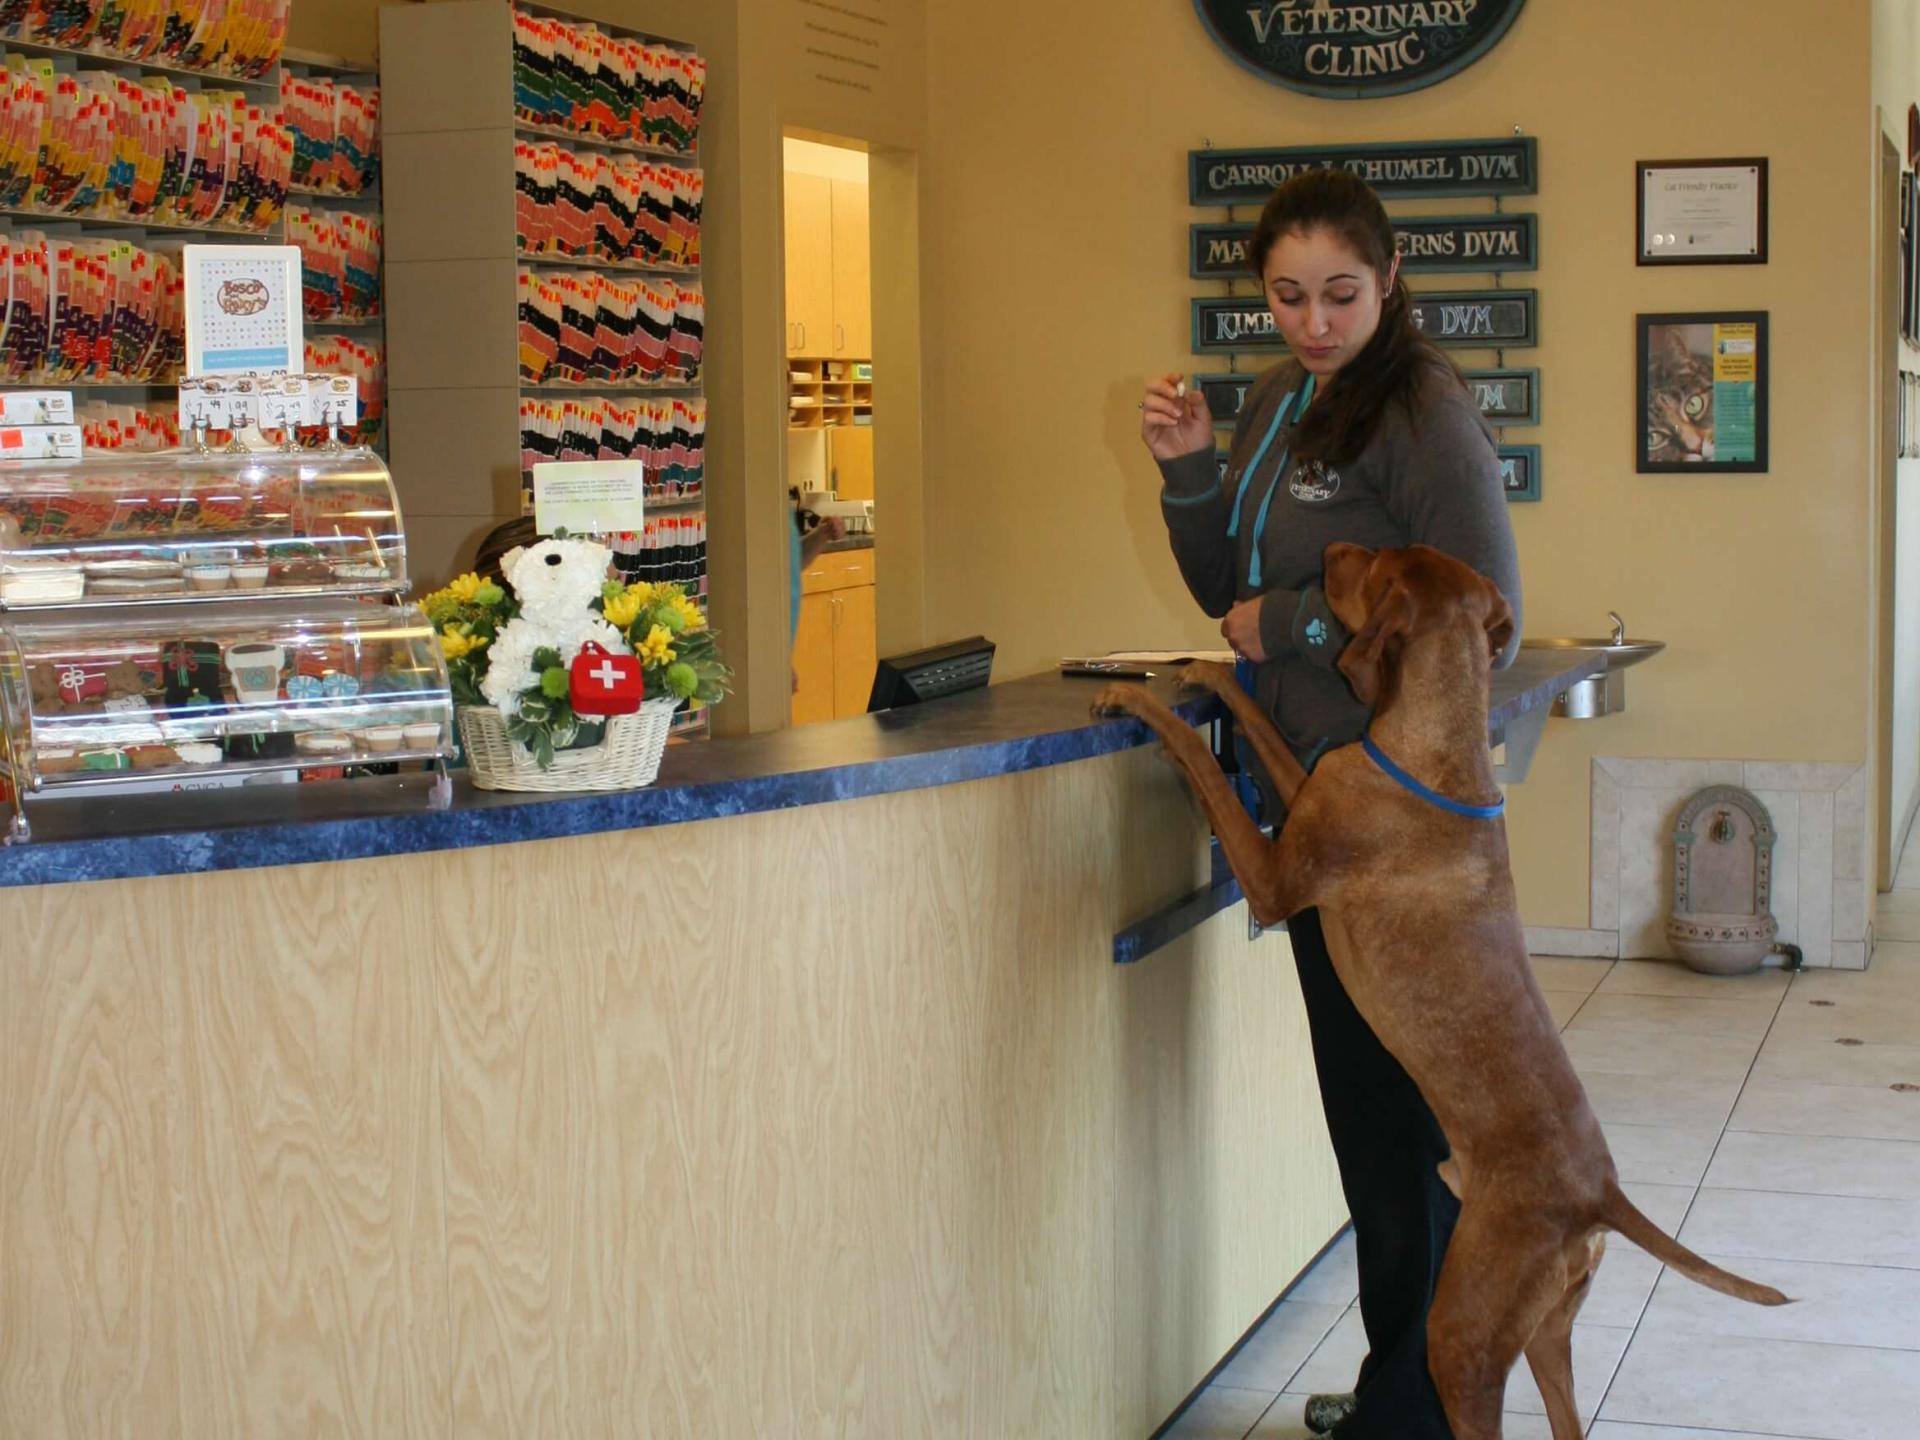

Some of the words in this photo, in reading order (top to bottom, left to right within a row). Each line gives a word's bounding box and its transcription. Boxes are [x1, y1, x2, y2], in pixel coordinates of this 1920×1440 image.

[1247, 0, 1477, 43] VETERINARY
[1305, 32, 1425, 76] CLINIC
[1344, 157, 1453, 182] THUMEL
[1460, 155, 1519, 181] DVM
[1395, 230, 1456, 253] ERNS
[1462, 231, 1520, 257] DVM
[1215, 312, 1281, 340] KIMB
[1440, 305, 1494, 334] DVM
